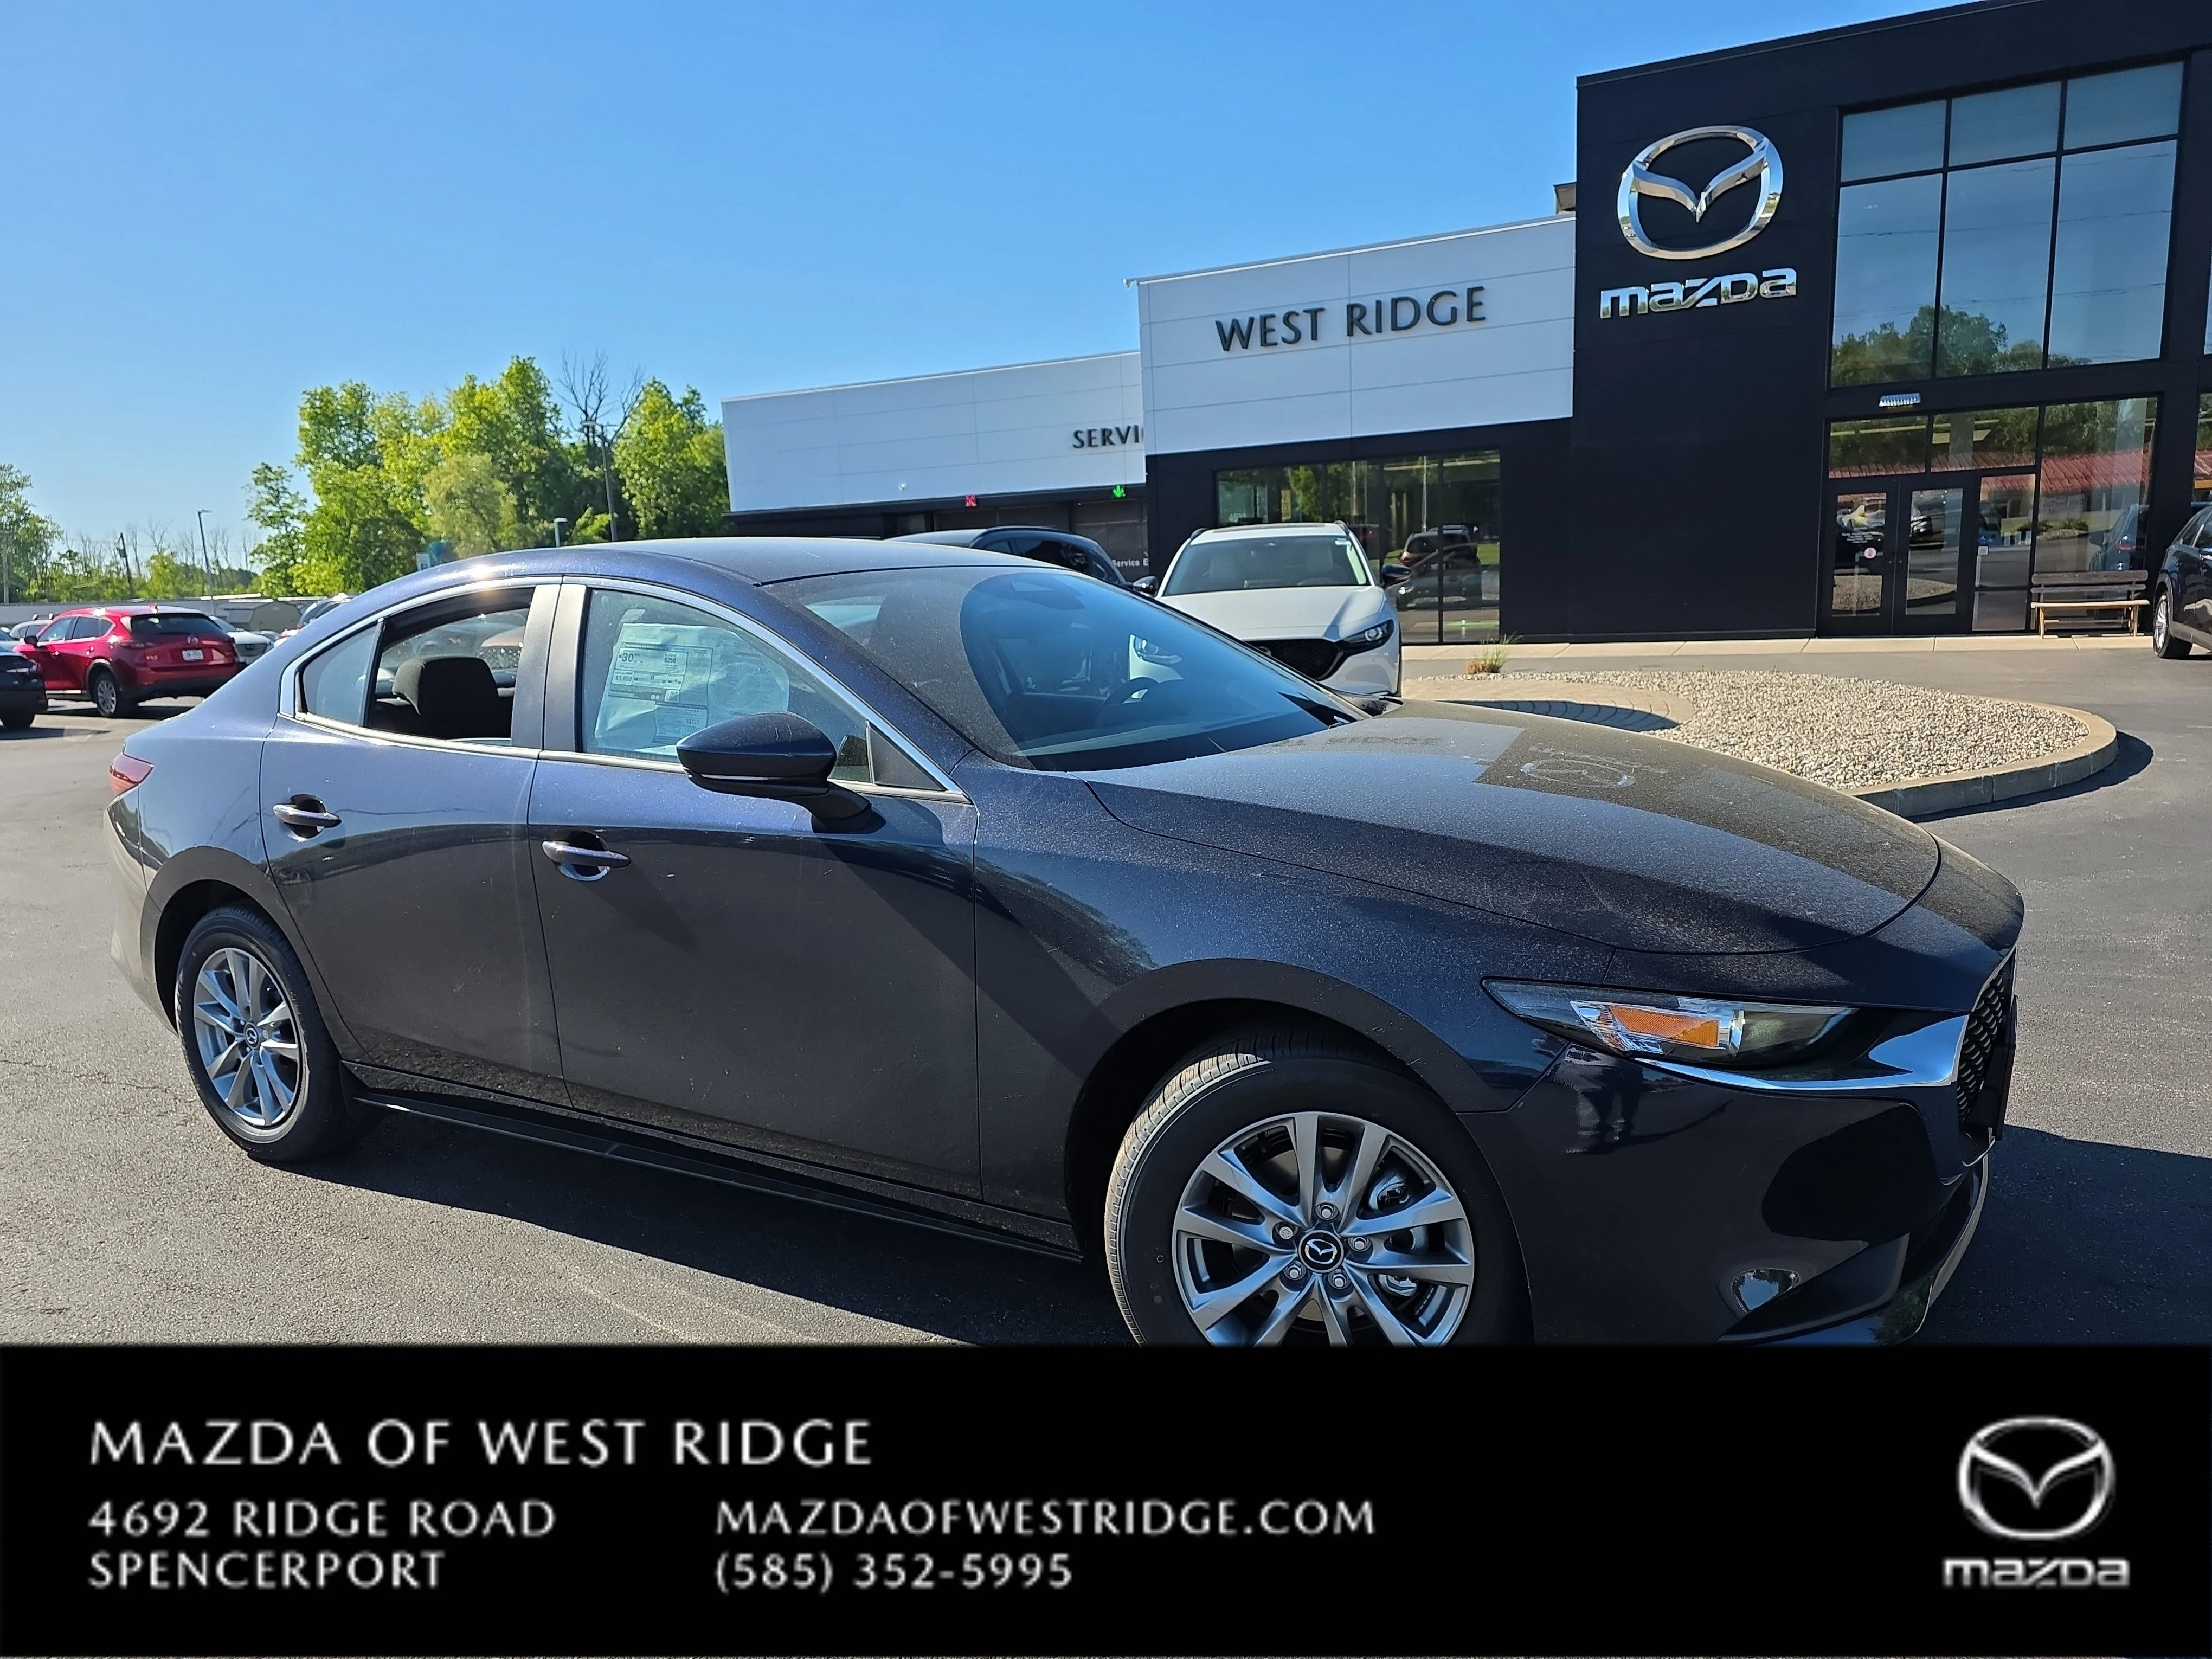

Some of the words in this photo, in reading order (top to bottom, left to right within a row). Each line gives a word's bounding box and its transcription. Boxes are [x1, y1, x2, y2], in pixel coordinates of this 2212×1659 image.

[1215, 307, 1326, 351] WEST
[1347, 286, 1486, 337] RIDGE
[1600, 268, 1797, 319] mazda
[1072, 425, 1144, 448] SERVI
